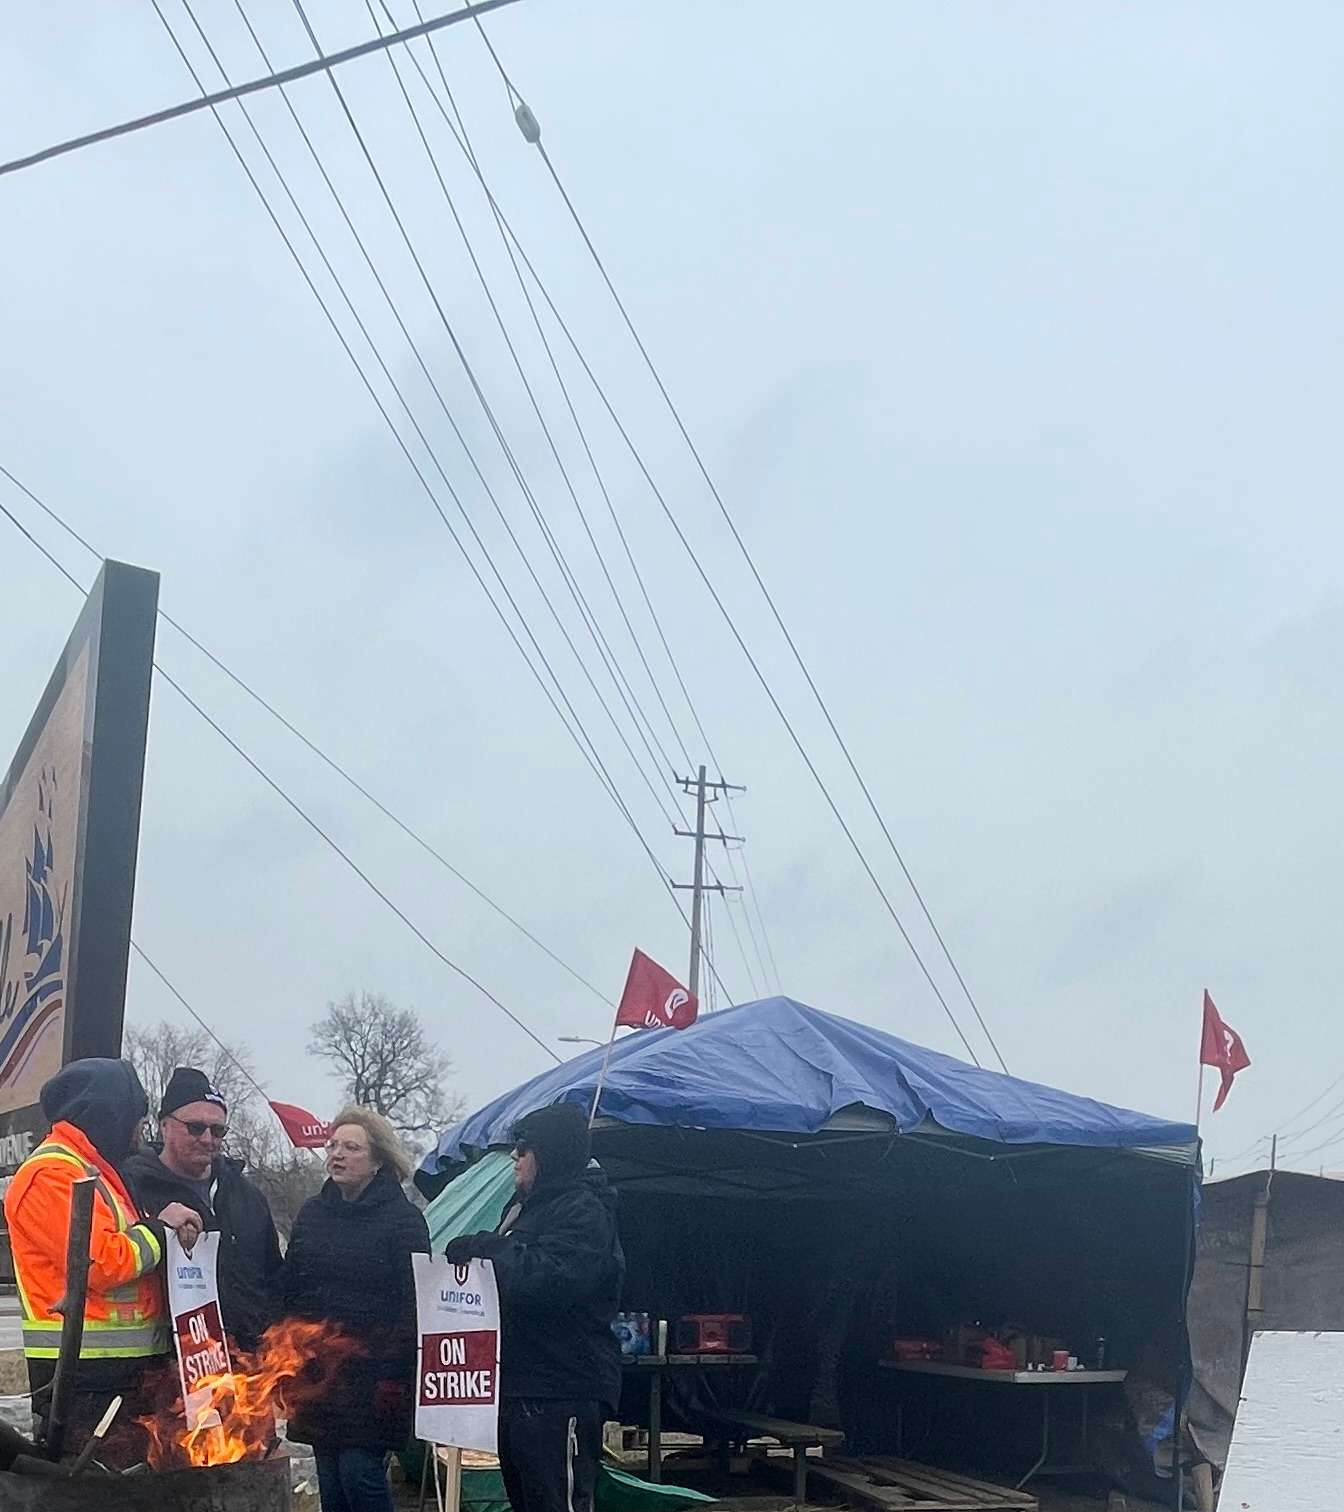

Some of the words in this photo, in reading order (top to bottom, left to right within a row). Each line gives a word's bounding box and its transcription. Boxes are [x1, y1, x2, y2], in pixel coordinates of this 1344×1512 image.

[189, 1312, 209, 1345] ON
[440, 1338, 466, 1366] ON
[425, 1370, 492, 1400] STRIKE
